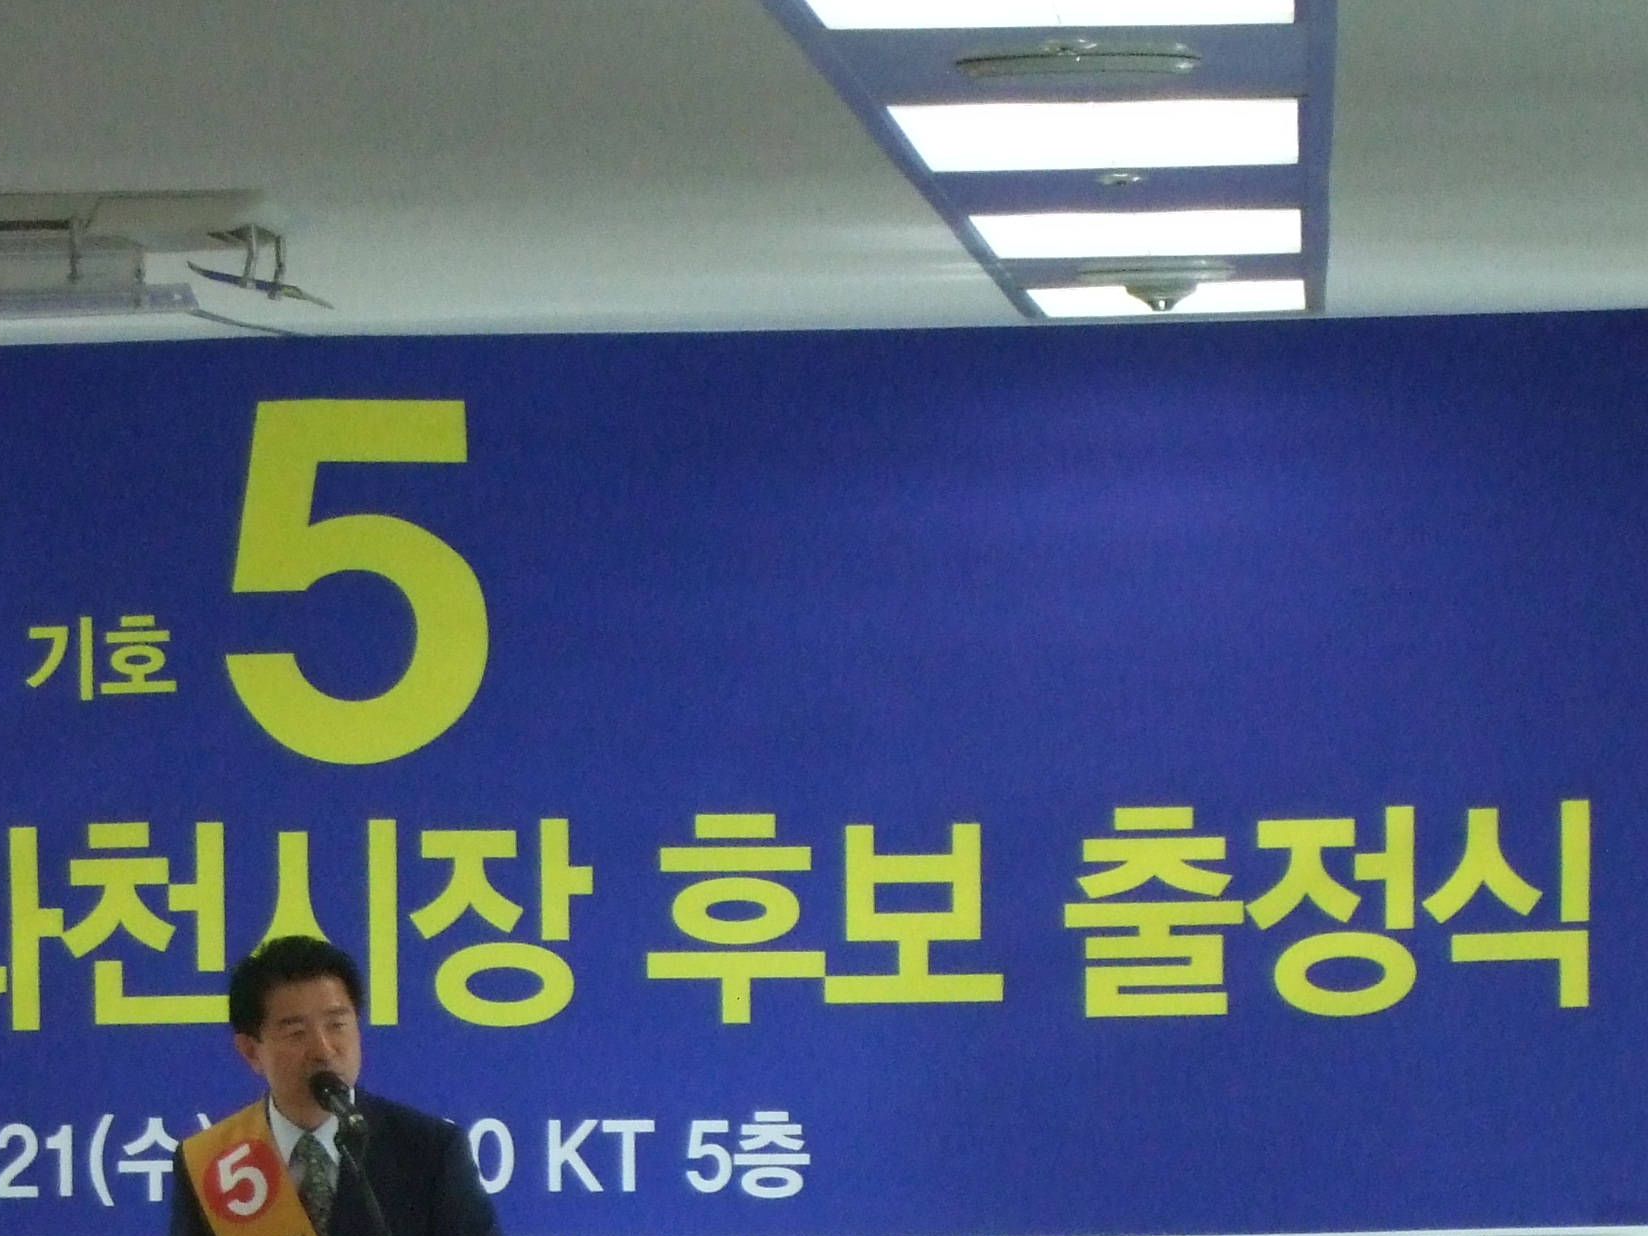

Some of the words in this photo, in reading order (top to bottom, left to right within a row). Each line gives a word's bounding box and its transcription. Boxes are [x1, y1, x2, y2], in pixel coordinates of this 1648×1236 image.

[25, 614, 178, 701] 기호
[224, 397, 490, 766] 5
[645, 813, 1004, 1024] 후보
[1064, 799, 1591, 1018] 출정식
[216, 1142, 269, 1216] 5
[547, 1119, 656, 1193] KT
[685, 1110, 811, 1199] 5층
